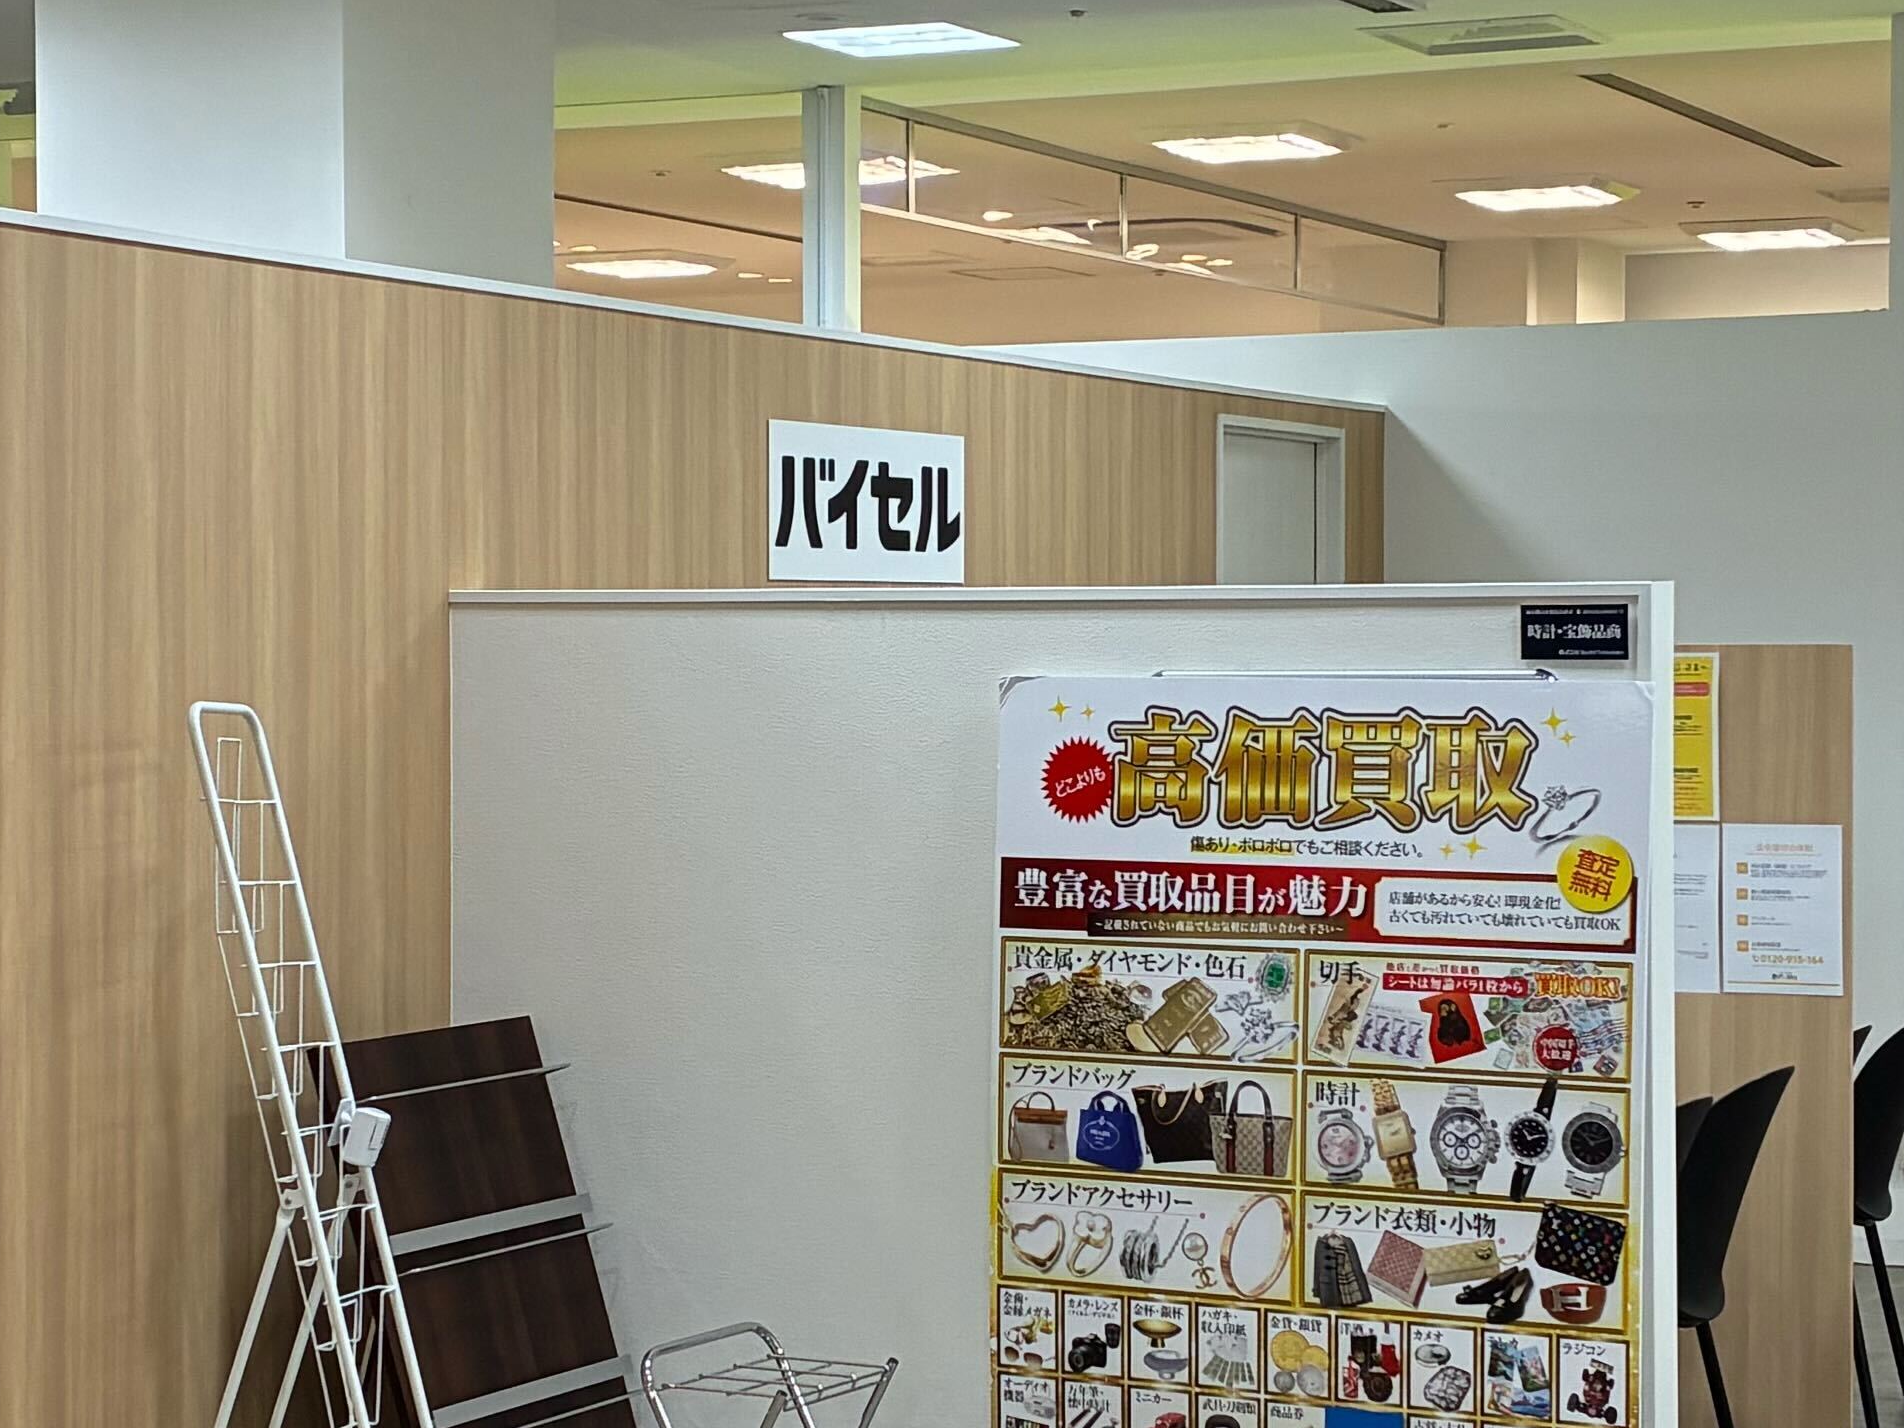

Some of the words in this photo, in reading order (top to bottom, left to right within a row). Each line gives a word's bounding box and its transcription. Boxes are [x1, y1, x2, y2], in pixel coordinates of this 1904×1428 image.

[775, 456, 960, 552] バイセル
[1055, 765, 1107, 798] どこよりも
[1110, 706, 1538, 834] 高価買取
[1577, 847, 1621, 879] 査定
[1014, 867, 1368, 918] 豊富な買取品目が魅力
[1568, 871, 1613, 903] 無料
[1013, 945, 1247, 980] 貴金属・ダイヤモンド・色石
[1319, 960, 1361, 985] 切手
[1012, 1062, 1136, 1090] ブランドバッグ
[1314, 1082, 1361, 1107] 時計
[1011, 1179, 1194, 1210] ブランドアクセサリー
[1313, 1203, 1497, 1238] ブランド衣類・小物
[1068, 1297, 1119, 1313] カメラ・レンズ
[1413, 1329, 1444, 1343] カメオ
[1562, 1342, 1607, 1357] ラジコン
[1135, 1390, 1172, 1404] ミニカー
